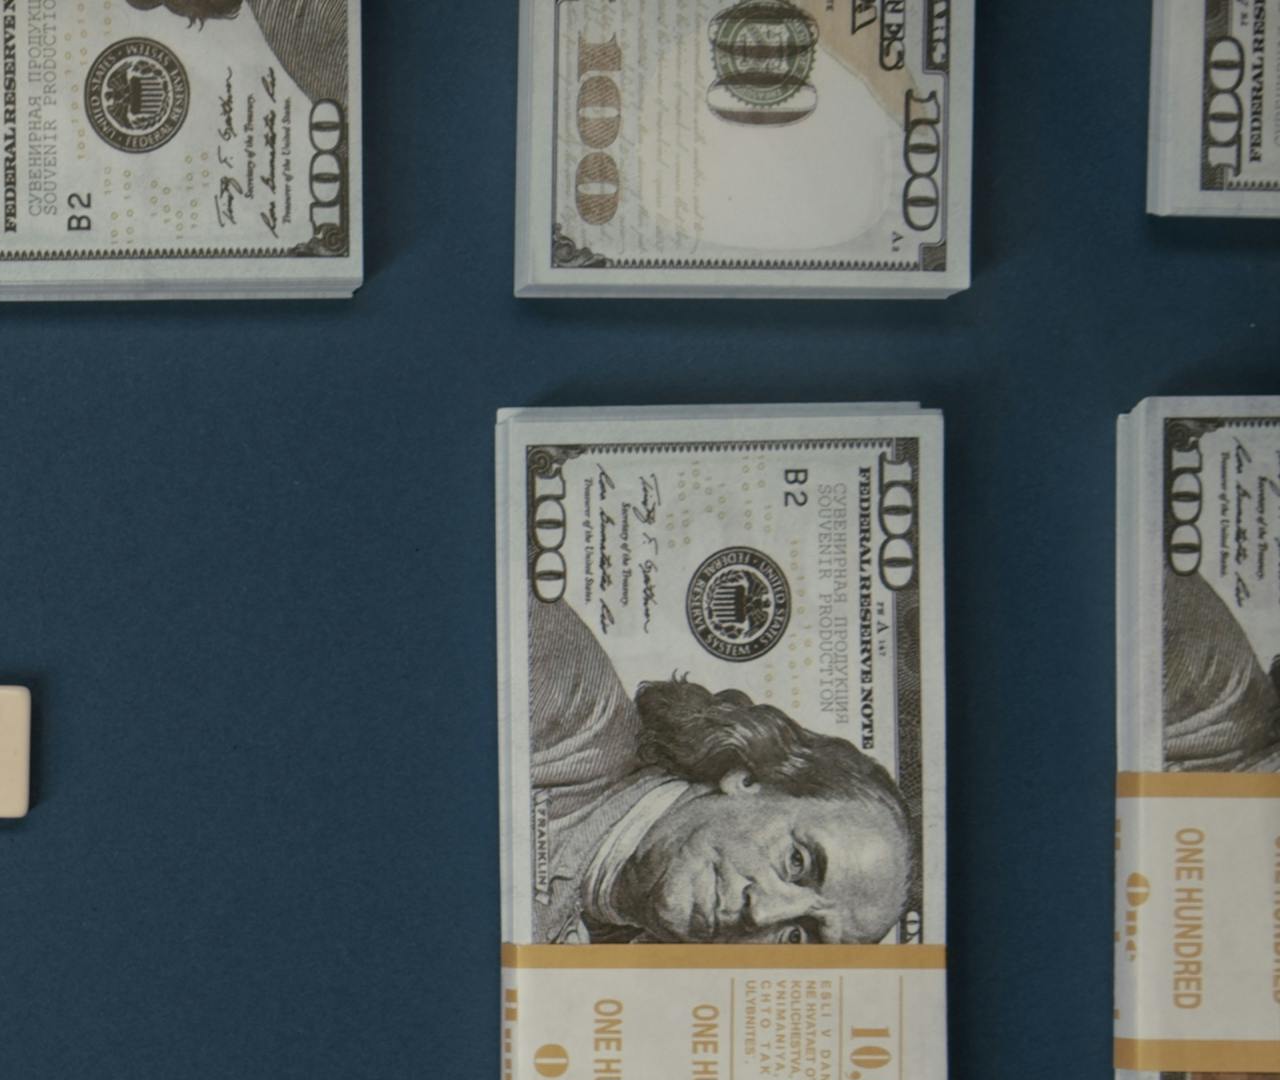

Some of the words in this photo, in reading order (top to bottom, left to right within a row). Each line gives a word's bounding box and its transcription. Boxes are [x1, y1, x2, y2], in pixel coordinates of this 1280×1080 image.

[2, 15, 17, 124] RESERVE
[1205, 34, 1246, 178] 100
[1248, 56, 1265, 163] FEDERAL
[3, 127, 17, 233] FEDERAL
[308, 98, 344, 235] 100
[572, 30, 623, 226] 100
[902, 90, 941, 231] 100
[531, 467, 567, 603] 100
[817, 484, 832, 580] SOUVENIR
[832, 483, 847, 603] СУВЕНИРНАЯ
[858, 466, 872, 572] FEDERAL
[878, 451, 914, 592] 100
[1166, 440, 1204, 576] 100
[818, 594, 833, 713] PRODUCTION
[833, 616, 849, 725] ПРОДУКЦИЯ
[859, 575, 873, 684] RESERVE
[860, 687, 874, 750] NOTE
[1175, 825, 1205, 881] ONE
[1172, 887, 1204, 1011] HUNDRED
[594, 998, 624, 1052] ONE
[691, 1004, 720, 1054] ONE
